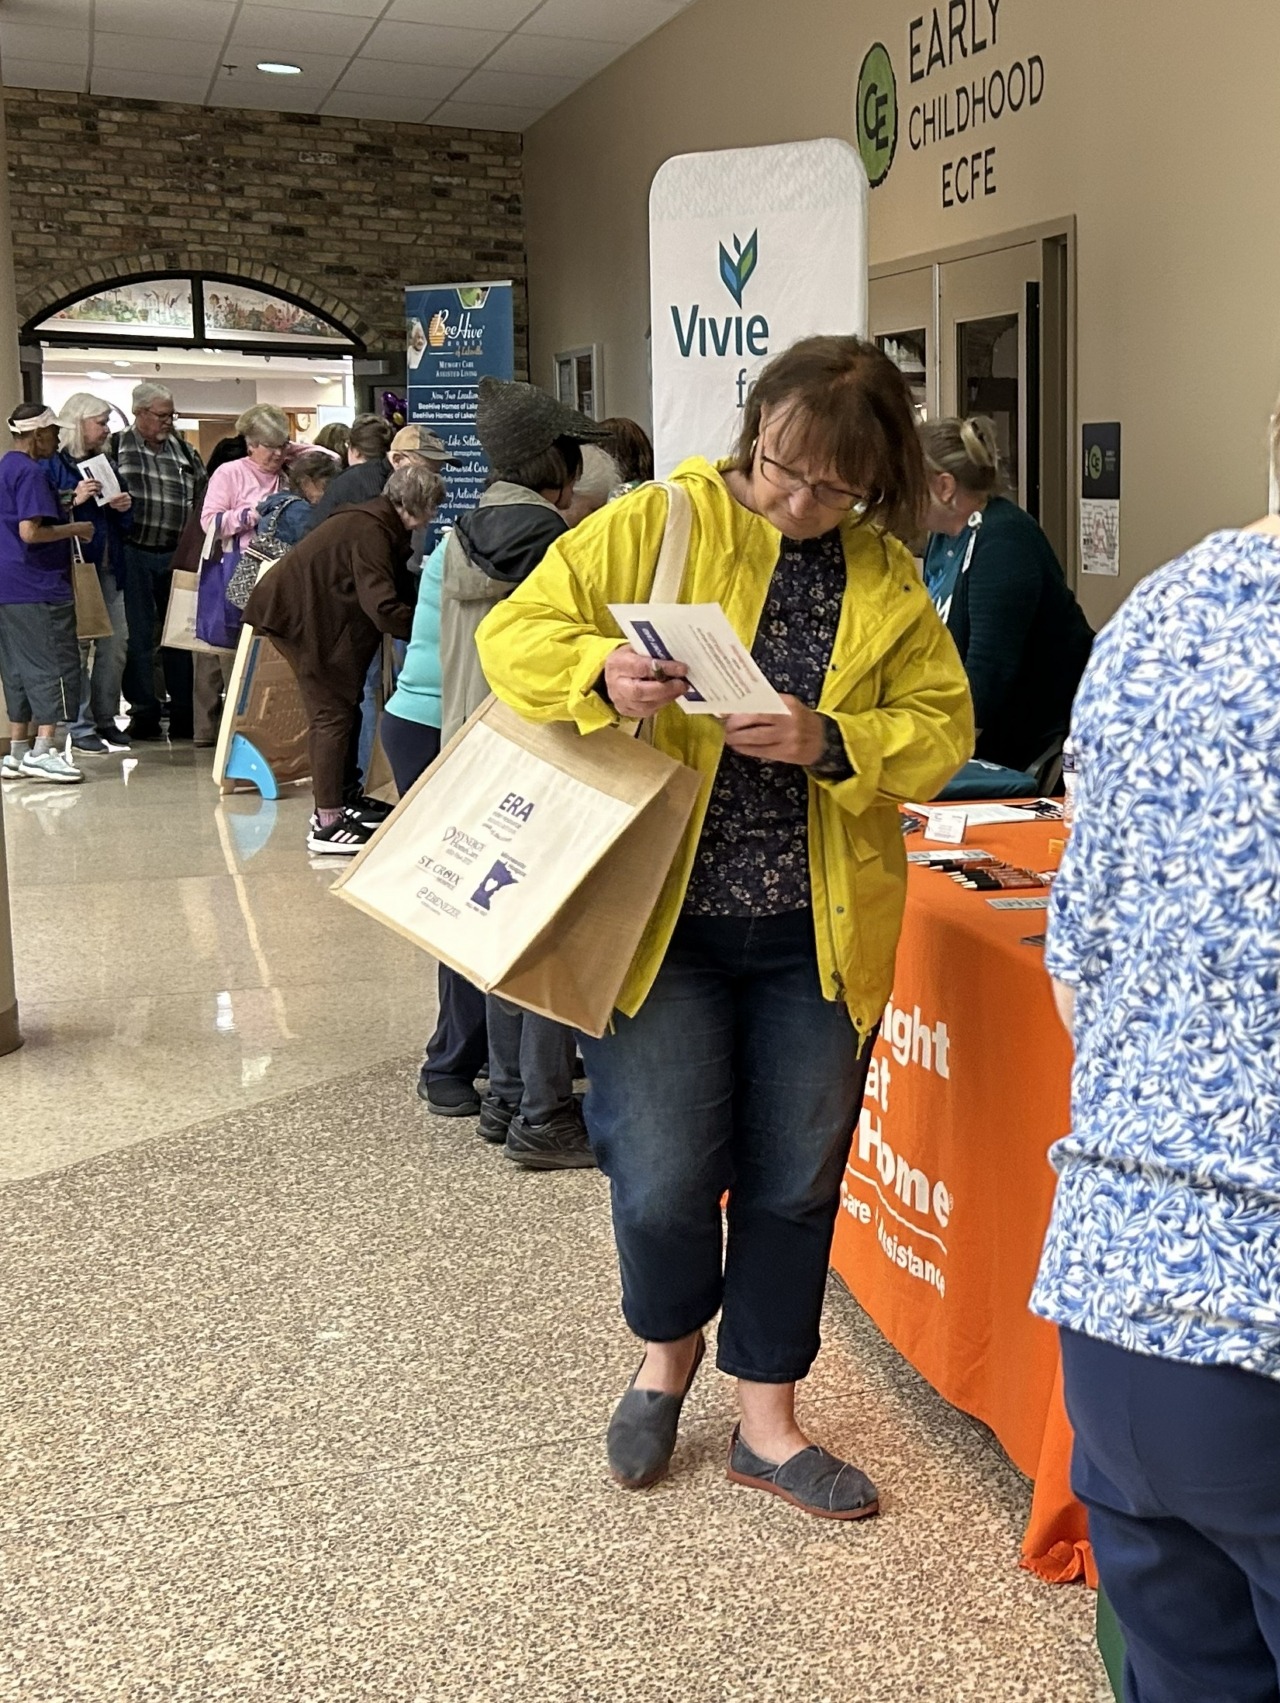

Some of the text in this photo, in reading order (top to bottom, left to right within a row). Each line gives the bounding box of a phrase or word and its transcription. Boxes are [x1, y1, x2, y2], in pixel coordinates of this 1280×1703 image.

[909, 0, 1000, 83] EARLY
[864, 82, 888, 152] CE
[909, 55, 1044, 150] CHILDHOOD
[942, 147, 996, 208] ECFE
[670, 304, 769, 357] Vivie
[499, 792, 535, 822] ERA
[880, 992, 949, 1080] ight
[865, 1057, 890, 1113] at
[859, 1107, 950, 1228] Home
